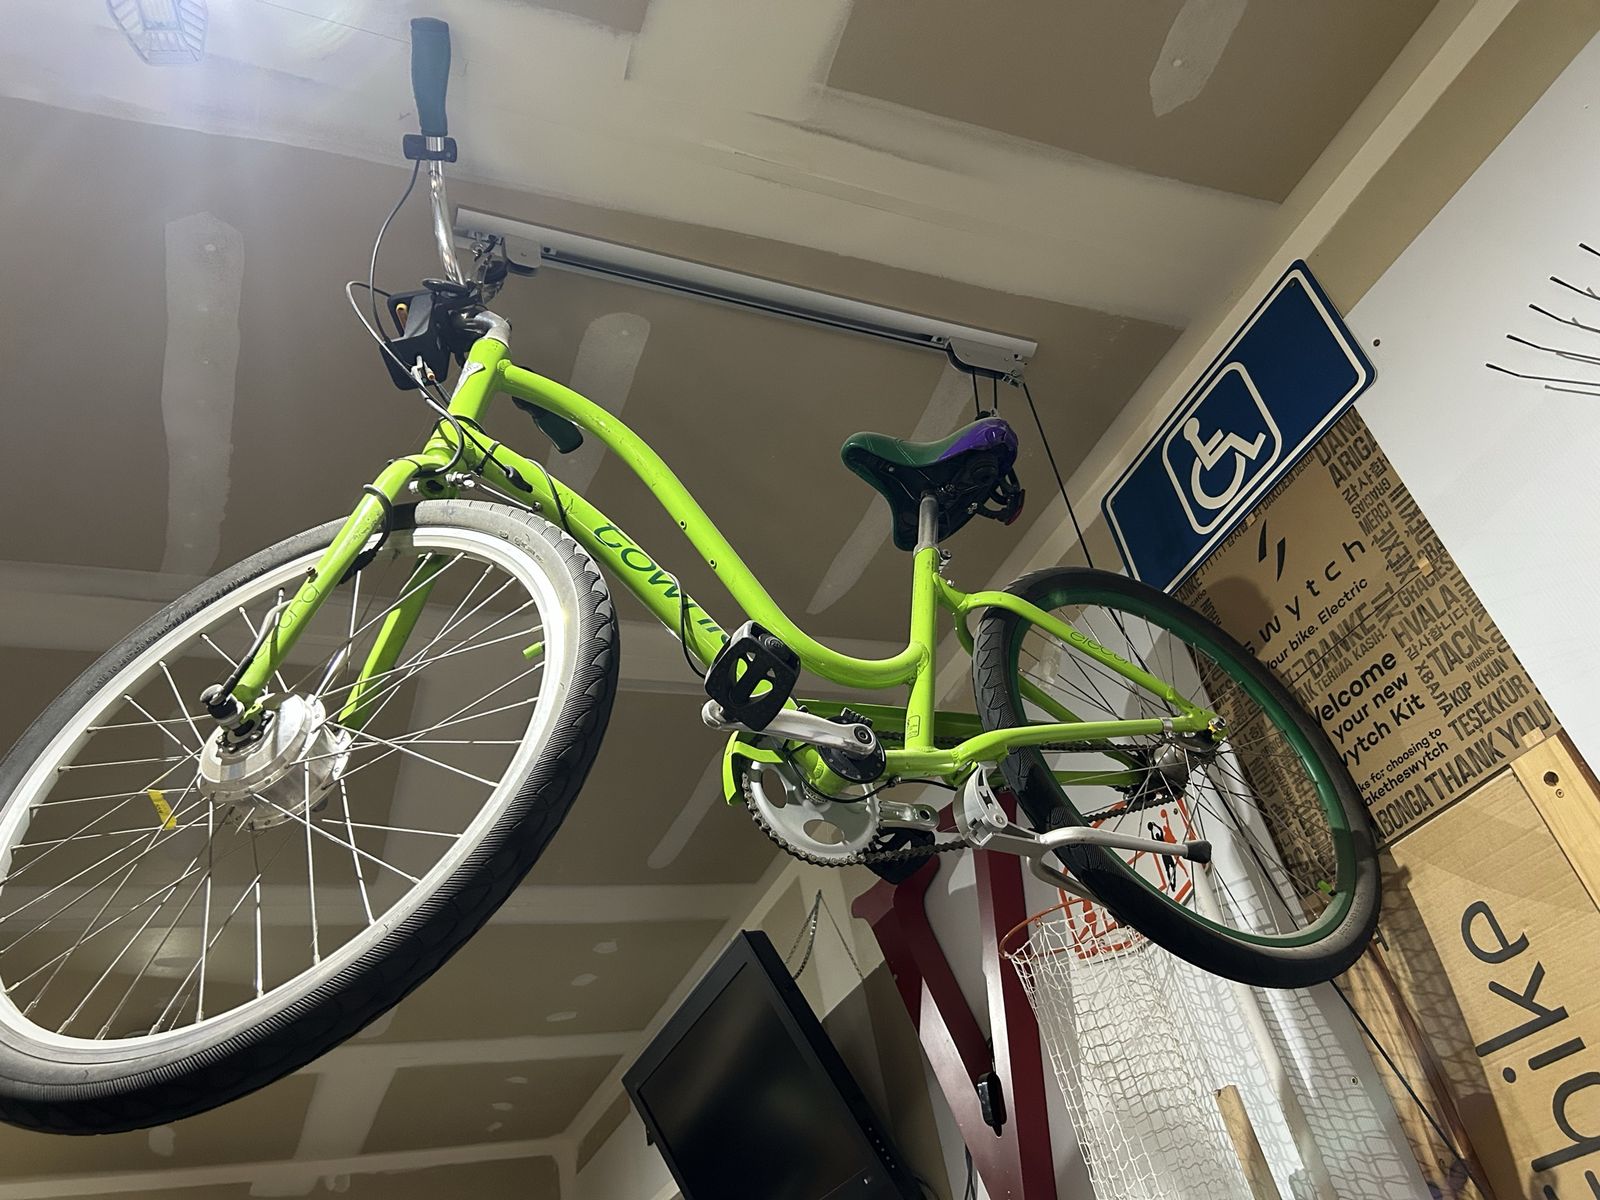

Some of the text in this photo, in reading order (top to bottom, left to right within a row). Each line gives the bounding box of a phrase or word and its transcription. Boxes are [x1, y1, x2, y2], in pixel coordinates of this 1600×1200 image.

[1352, 478, 1391, 518] GRACIAS
[1358, 500, 1392, 536] MERCI
[1289, 623, 1319, 656] bike.
[1318, 577, 1369, 625] Electric
[1307, 602, 1377, 681] DANKE
[1391, 584, 1461, 648] HVALA
[1405, 605, 1469, 661] 감사합니다
[1314, 656, 1353, 690] TERIMA
[1426, 618, 1489, 676] TACK
[1332, 697, 1372, 744] your
[1371, 672, 1409, 711] new
[1449, 680, 1472, 707] KOP
[1472, 655, 1509, 690] KHUN
[1393, 693, 1426, 727] Kit
[1363, 739, 1449, 808] aketheswytch
[1385, 736, 1432, 774] choosing
[1427, 727, 1442, 747] to
[1424, 732, 1506, 802] THANK
